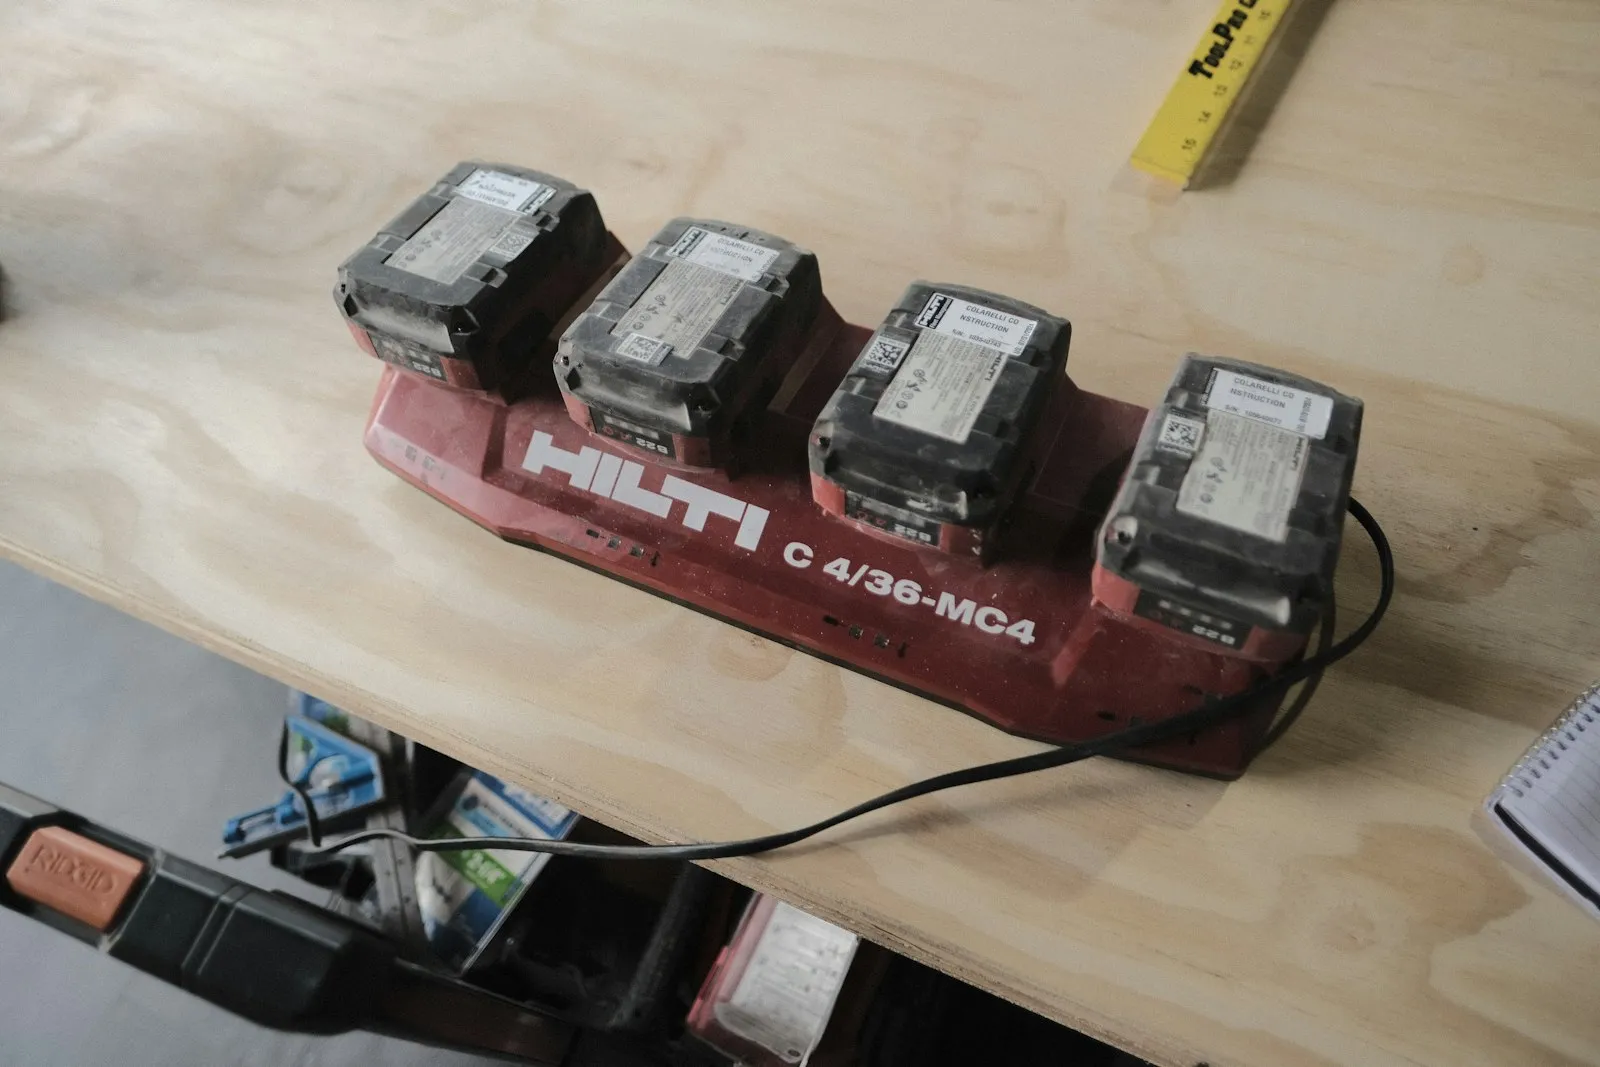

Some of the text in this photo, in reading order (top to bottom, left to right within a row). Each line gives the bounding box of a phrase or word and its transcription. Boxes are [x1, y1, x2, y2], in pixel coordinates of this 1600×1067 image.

[1198, 111, 1211, 123] 14
[1181, 138, 1197, 151] 15
[919, 294, 945, 327] HILTI
[966, 305, 1020, 325] COLARELLI CO
[959, 314, 1009, 334] NSTRUCTION
[1230, 387, 1286, 409] NSTRUCTION
[1233, 377, 1295, 399] COLARELLI CO
[521, 431, 770, 552] HILTI
[782, 541, 1036, 647] C 4/36-MC4
[25, 844, 118, 894] RIDGID
